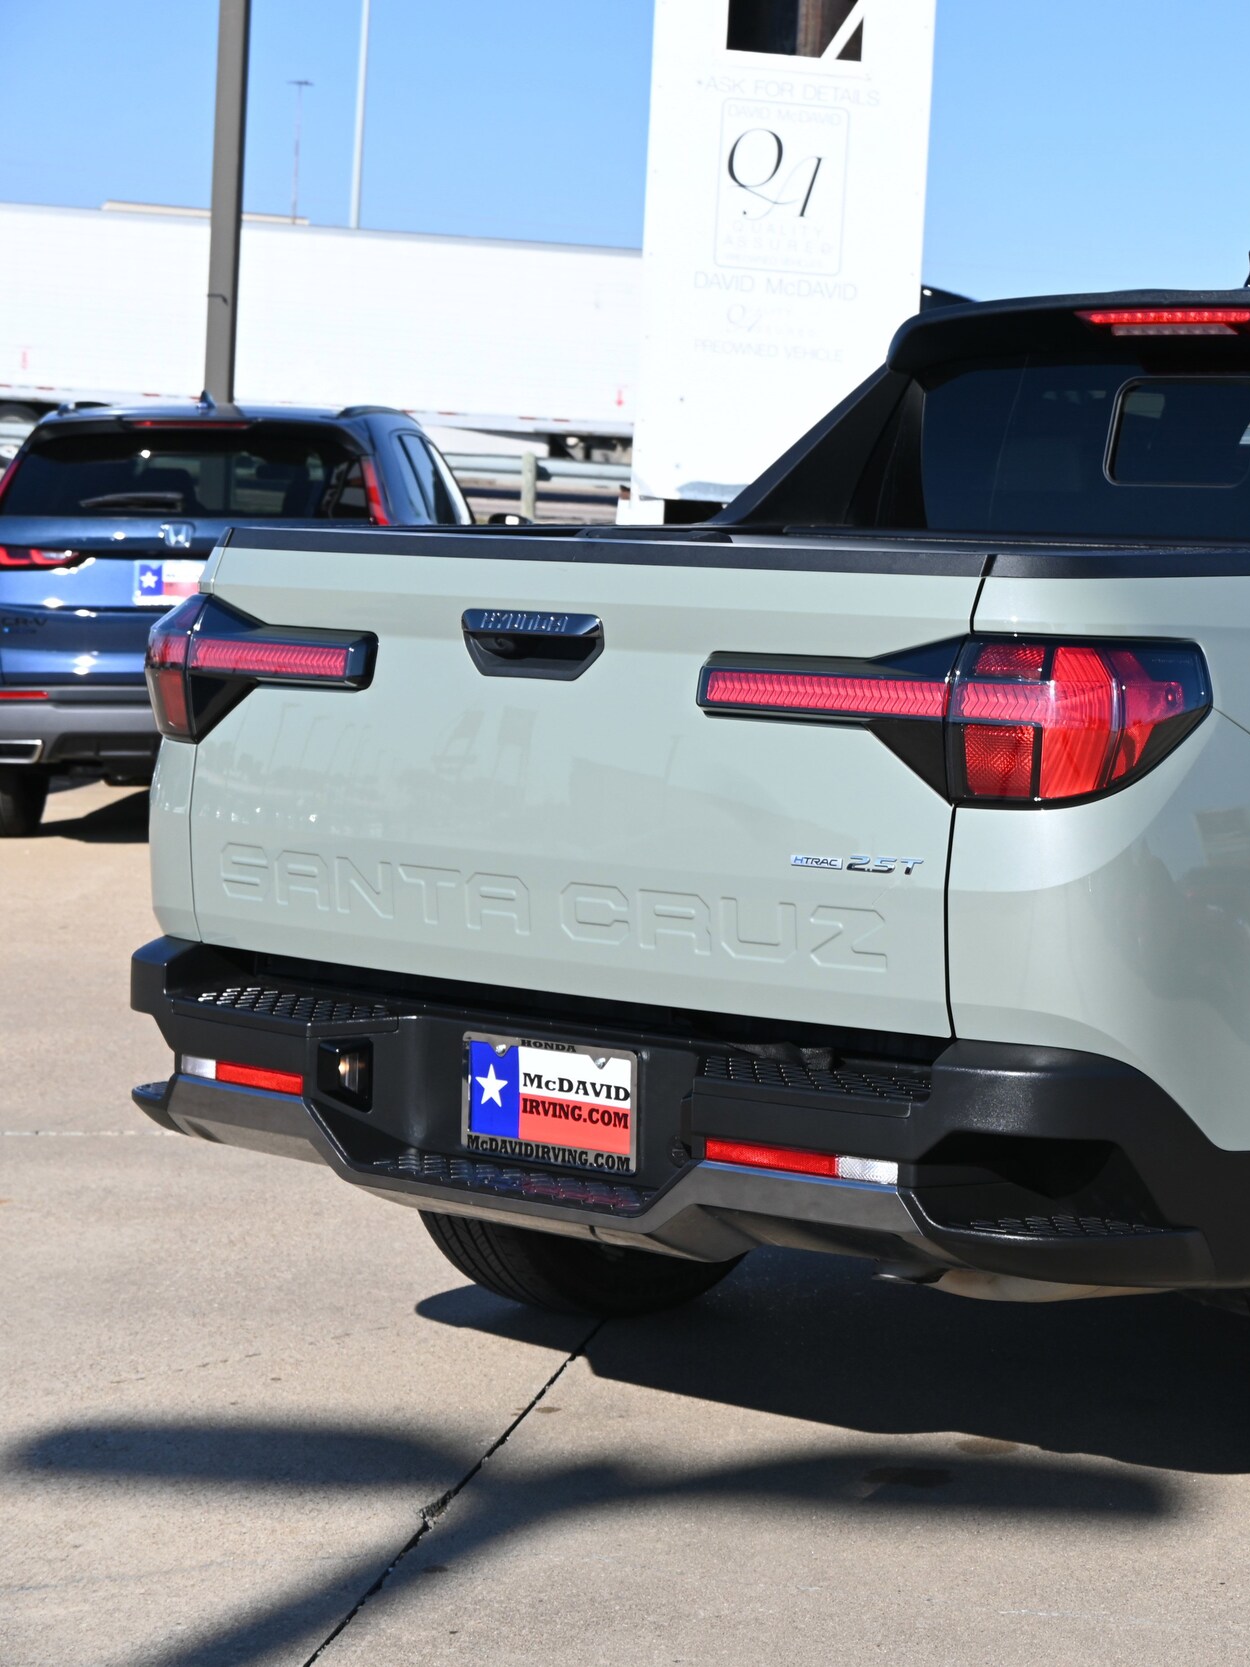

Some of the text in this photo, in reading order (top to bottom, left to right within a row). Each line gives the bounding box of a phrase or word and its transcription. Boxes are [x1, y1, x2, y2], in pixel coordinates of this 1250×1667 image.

[754, 79, 794, 98] FOR
[803, 84, 880, 107] DETAILS
[694, 271, 858, 301] DAVID McDAVID
[784, 346, 844, 362] VEHICLE
[480, 612, 568, 632] HYUNDAI
[793, 855, 838, 868] HTRAC
[220, 842, 888, 972] SANTA CRUZ
[521, 1039, 577, 1053] HONDA
[522, 1072, 631, 1103] McDAVID
[522, 1097, 629, 1129] IRVING.COM
[466, 1134, 631, 1172] McDAVIDIRVING.COM
